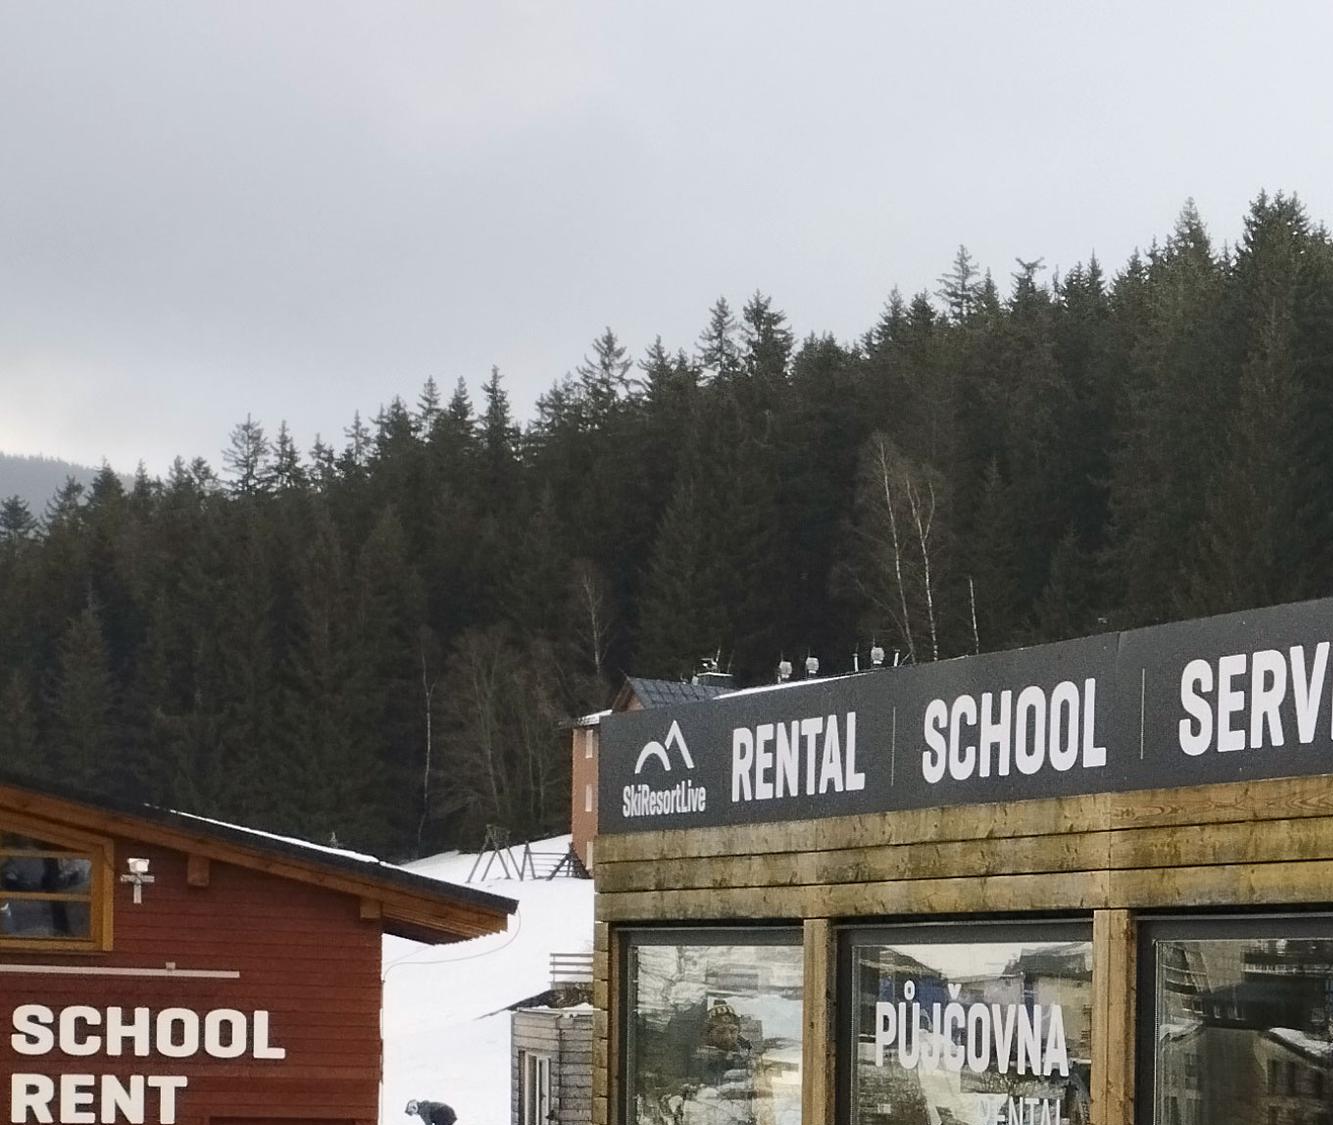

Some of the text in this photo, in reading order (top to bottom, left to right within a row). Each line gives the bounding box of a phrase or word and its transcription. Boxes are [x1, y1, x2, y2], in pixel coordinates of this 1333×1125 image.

[731, 710, 866, 803] RENTAL
[922, 677, 1108, 784] SCHOOL
[622, 779, 706, 818] SkiResortLive
[11, 1003, 286, 1060] SCHOOL
[875, 979, 1070, 1077] PŮJČOVNA
[11, 1072, 188, 1125] RENT
